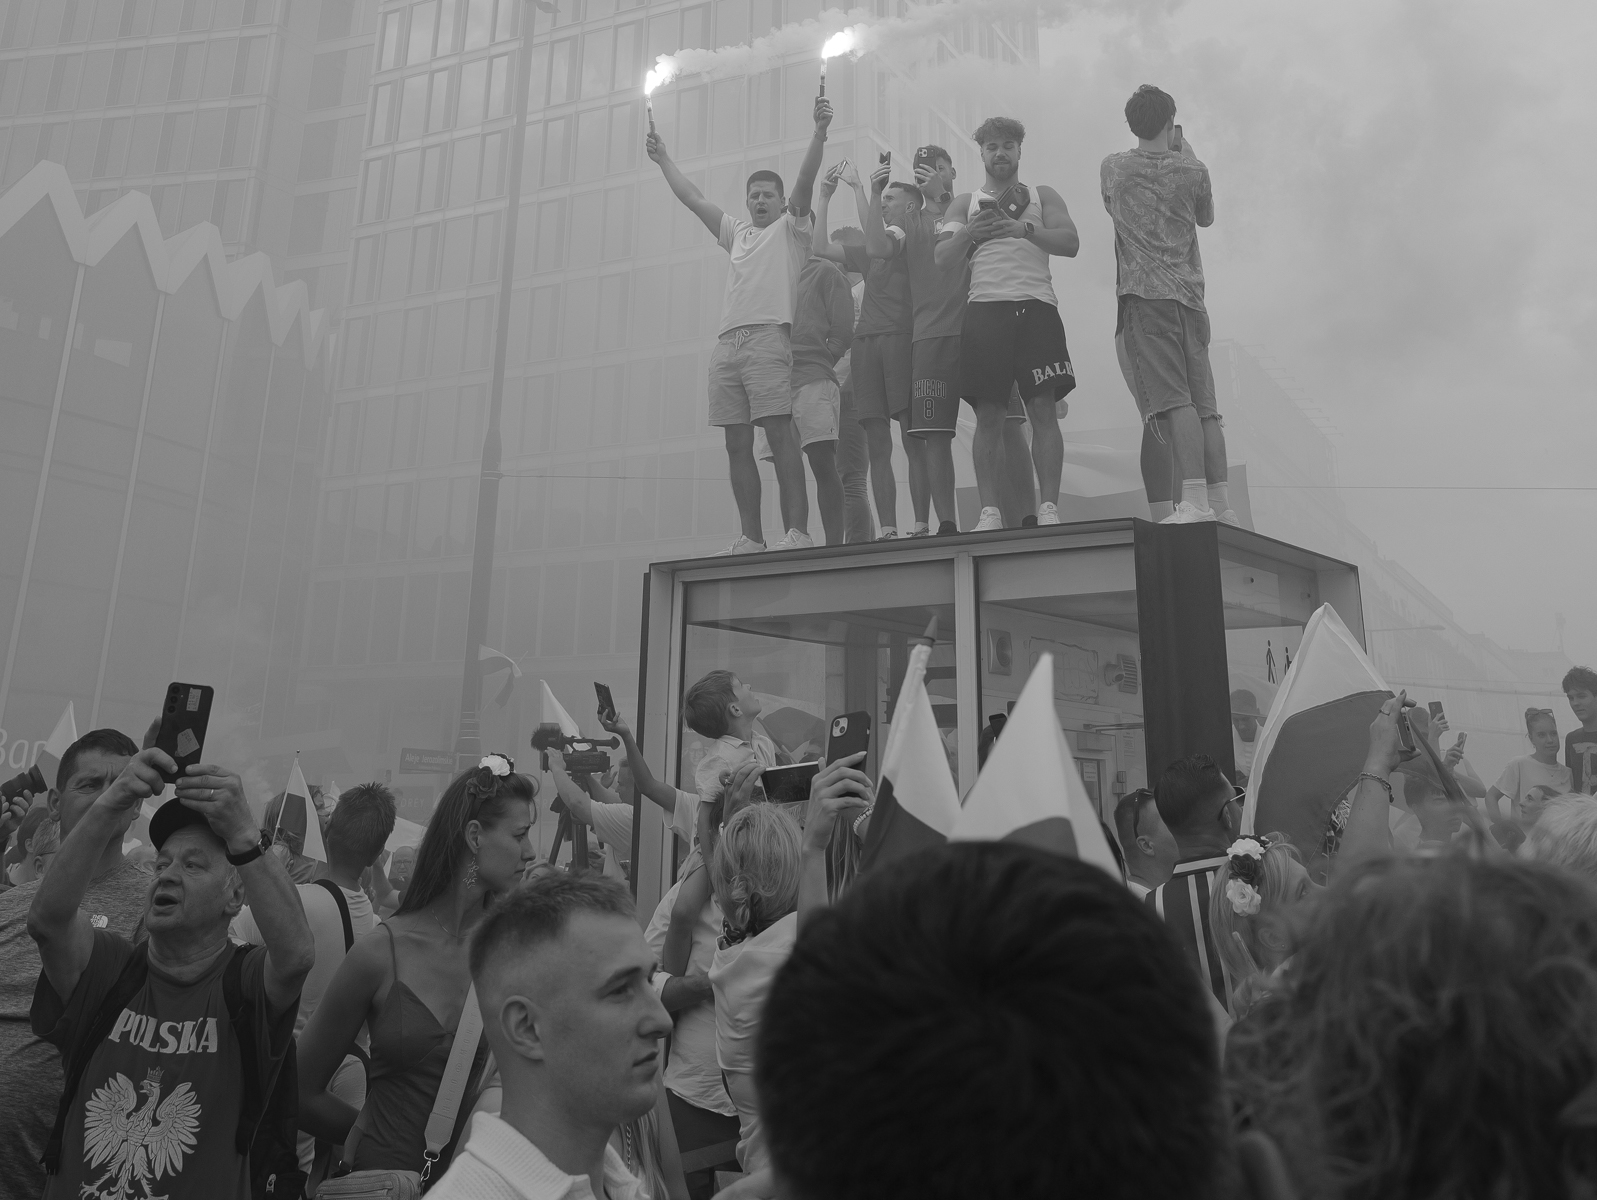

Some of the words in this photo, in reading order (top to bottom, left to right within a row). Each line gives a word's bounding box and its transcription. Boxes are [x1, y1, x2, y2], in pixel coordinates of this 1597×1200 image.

[913, 378, 947, 400] CHICAGO
[923, 397, 935, 420] 8
[405, 753, 420, 765] Aleje
[107, 1007, 218, 1055] POLSKA
